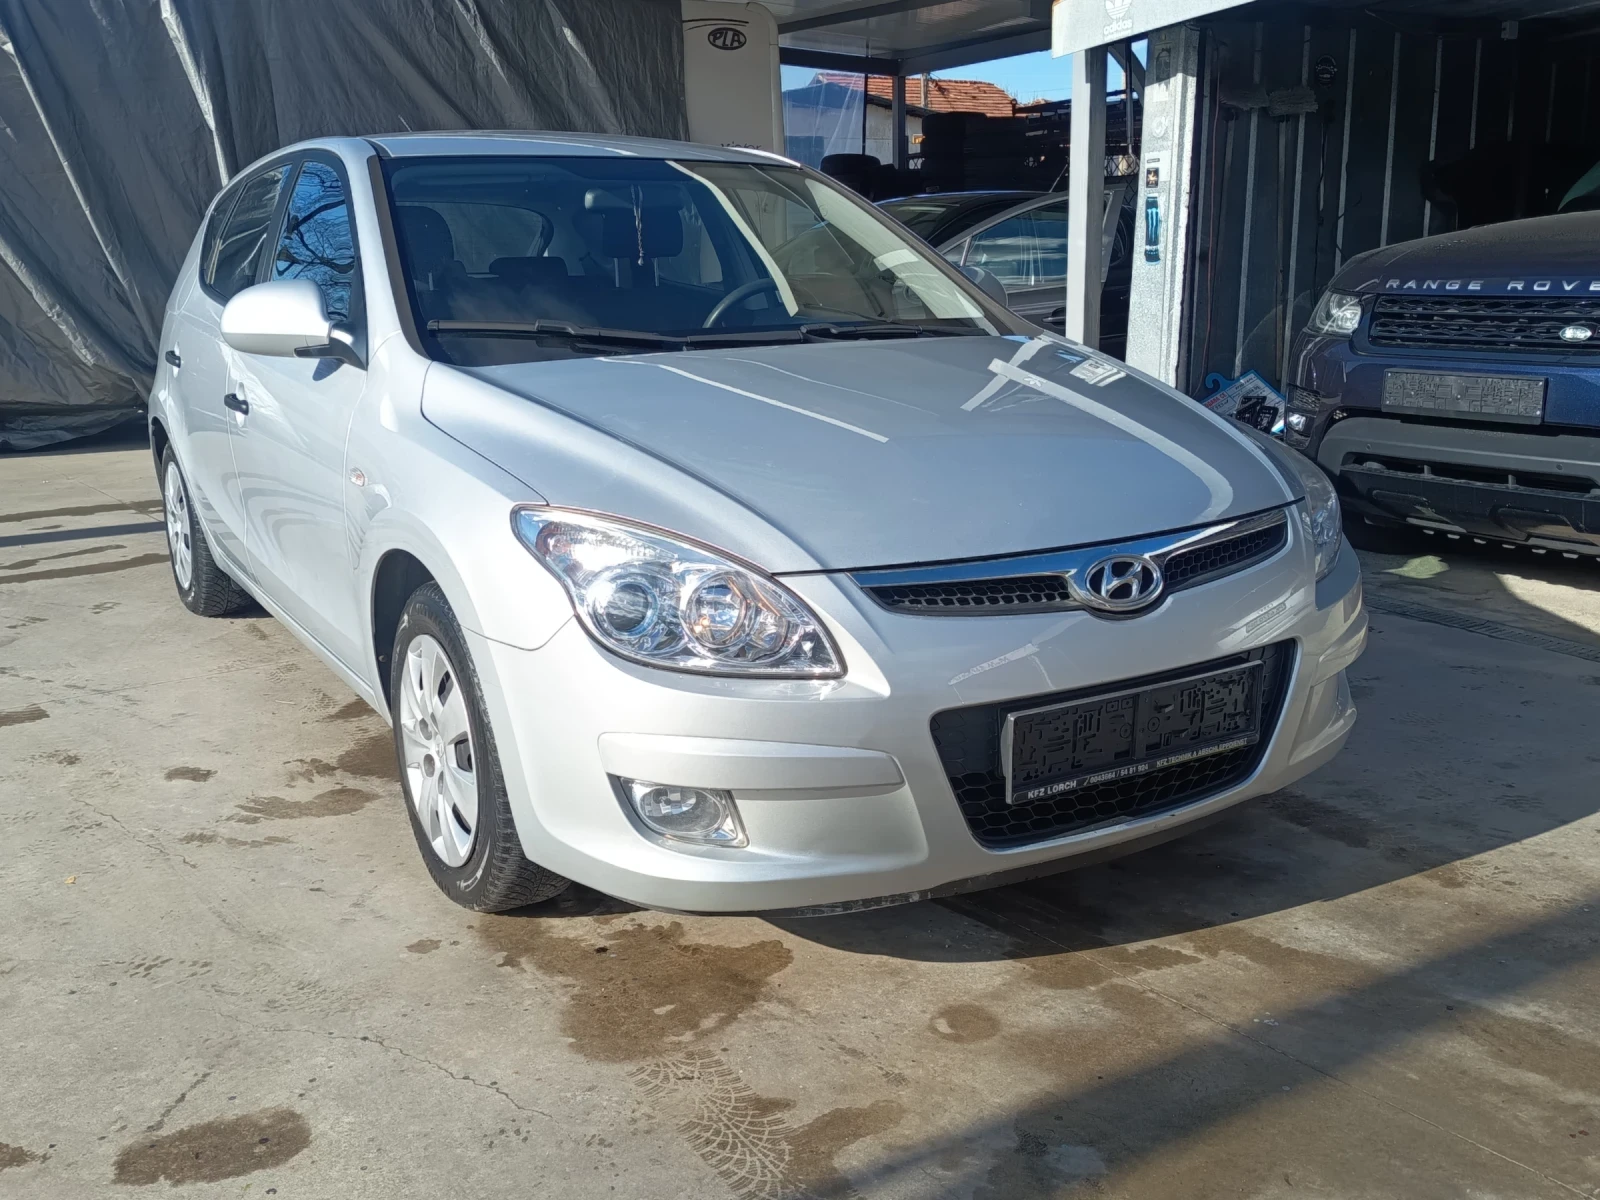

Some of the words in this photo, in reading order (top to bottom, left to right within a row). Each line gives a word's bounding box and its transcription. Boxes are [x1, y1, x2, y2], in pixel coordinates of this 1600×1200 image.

[1103, 20, 1132, 35] adidas
[1386, 279, 1484, 290] RANGE
[1028, 788, 1045, 799] KFZ
[1047, 780, 1077, 794] LORCH
[1156, 758, 1168, 768] KFZ
